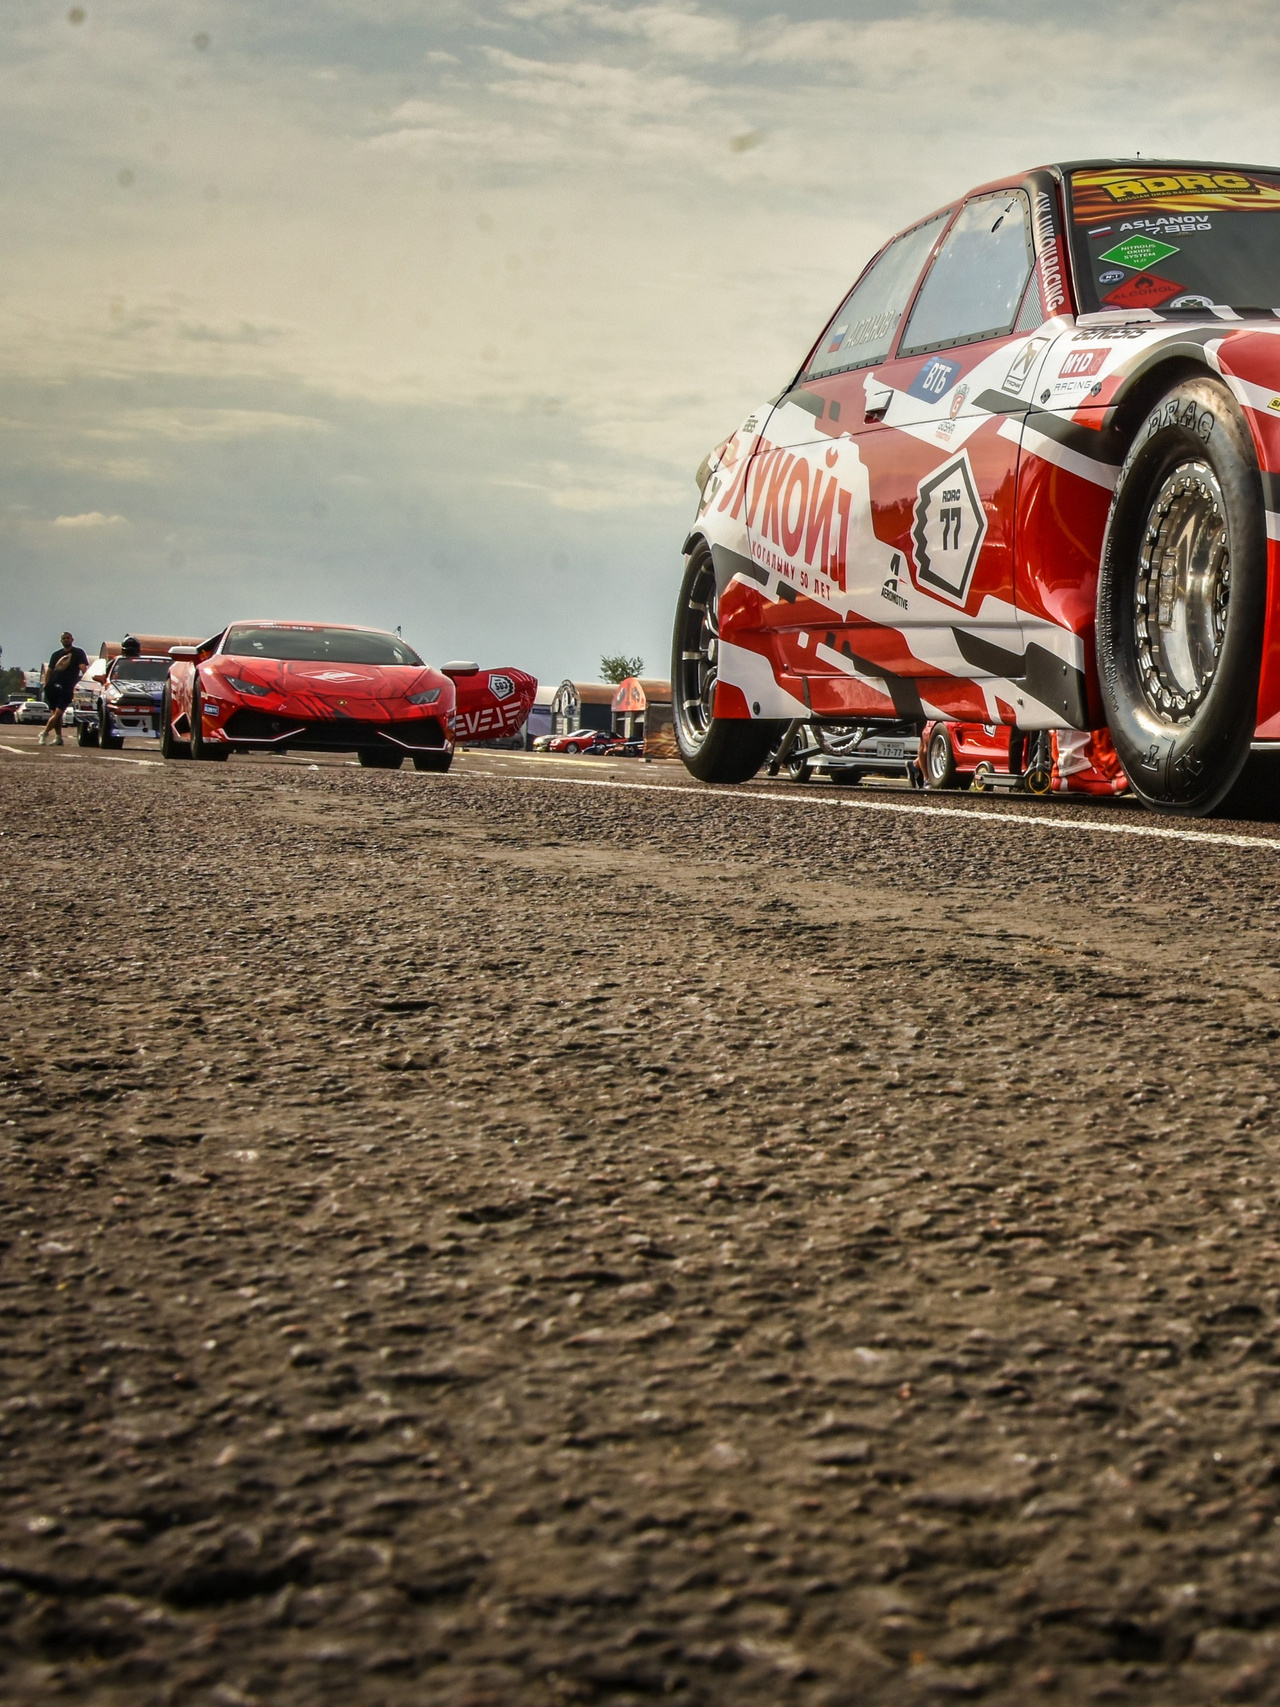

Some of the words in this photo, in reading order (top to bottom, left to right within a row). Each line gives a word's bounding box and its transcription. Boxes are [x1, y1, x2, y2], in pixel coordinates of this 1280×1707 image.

[1103, 174, 1250, 199] RDRC
[1117, 194, 1150, 203] RUSSIAN
[1120, 215, 1209, 231] ASLANOV
[1124, 252, 1156, 260] SYSTEM
[1113, 286, 1176, 300] ALCOHOL
[1072, 326, 1155, 341] GENESIS
[1061, 352, 1094, 374] M1D
[922, 362, 952, 394] ВТБ
[1054, 380, 1092, 392] RACING
[1148, 399, 1214, 444] DRAG
[942, 489, 960, 502] RDRC
[940, 507, 961, 551] 77
[751, 540, 795, 580] КОГАЛЫМУ
[800, 571, 809, 589] 50
[814, 578, 831, 601] ЛЕТ
[881, 587, 908, 610] AEROMOTIVE
[494, 681, 508, 691] 503
[882, 748, 902, 756] 77-77
